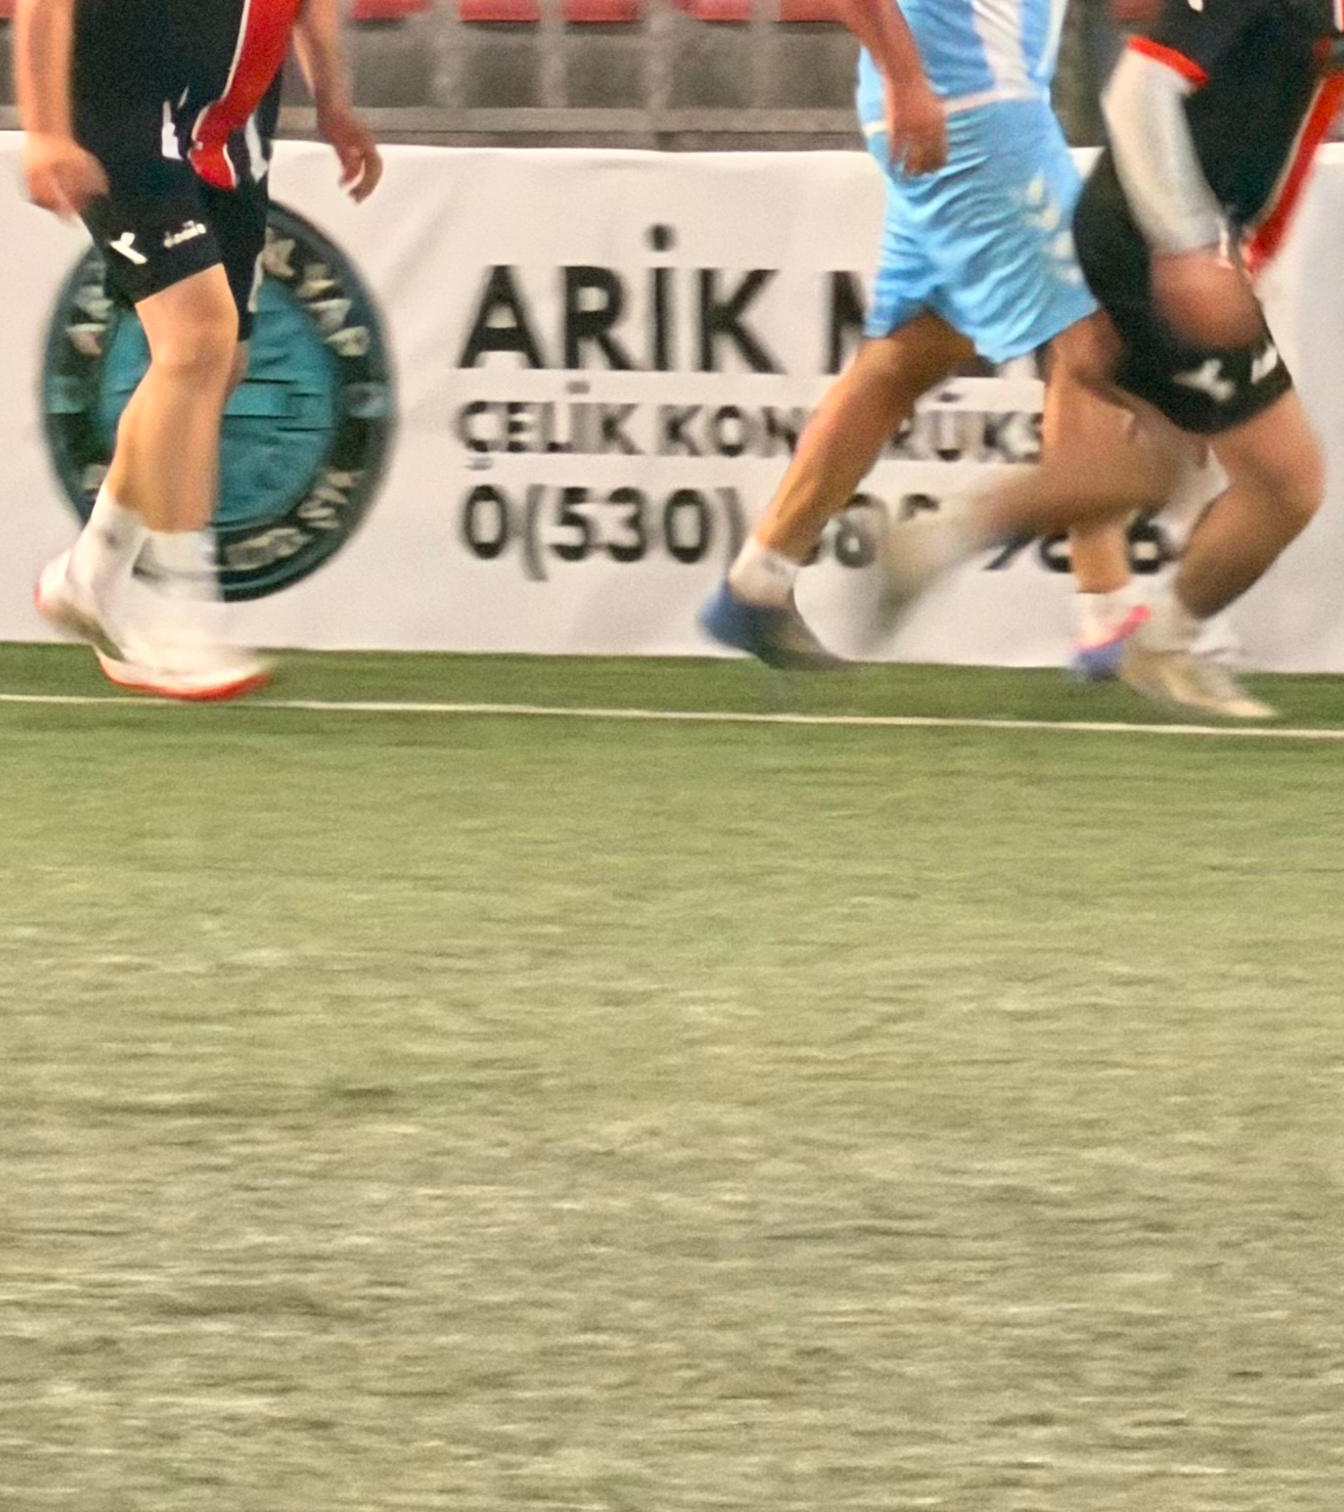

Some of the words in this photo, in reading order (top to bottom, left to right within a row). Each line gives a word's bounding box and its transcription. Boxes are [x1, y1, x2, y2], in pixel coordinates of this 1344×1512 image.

[456, 223, 786, 375] ARİK
[456, 380, 644, 472] ÇELİK
[463, 483, 744, 584] 0(530)
